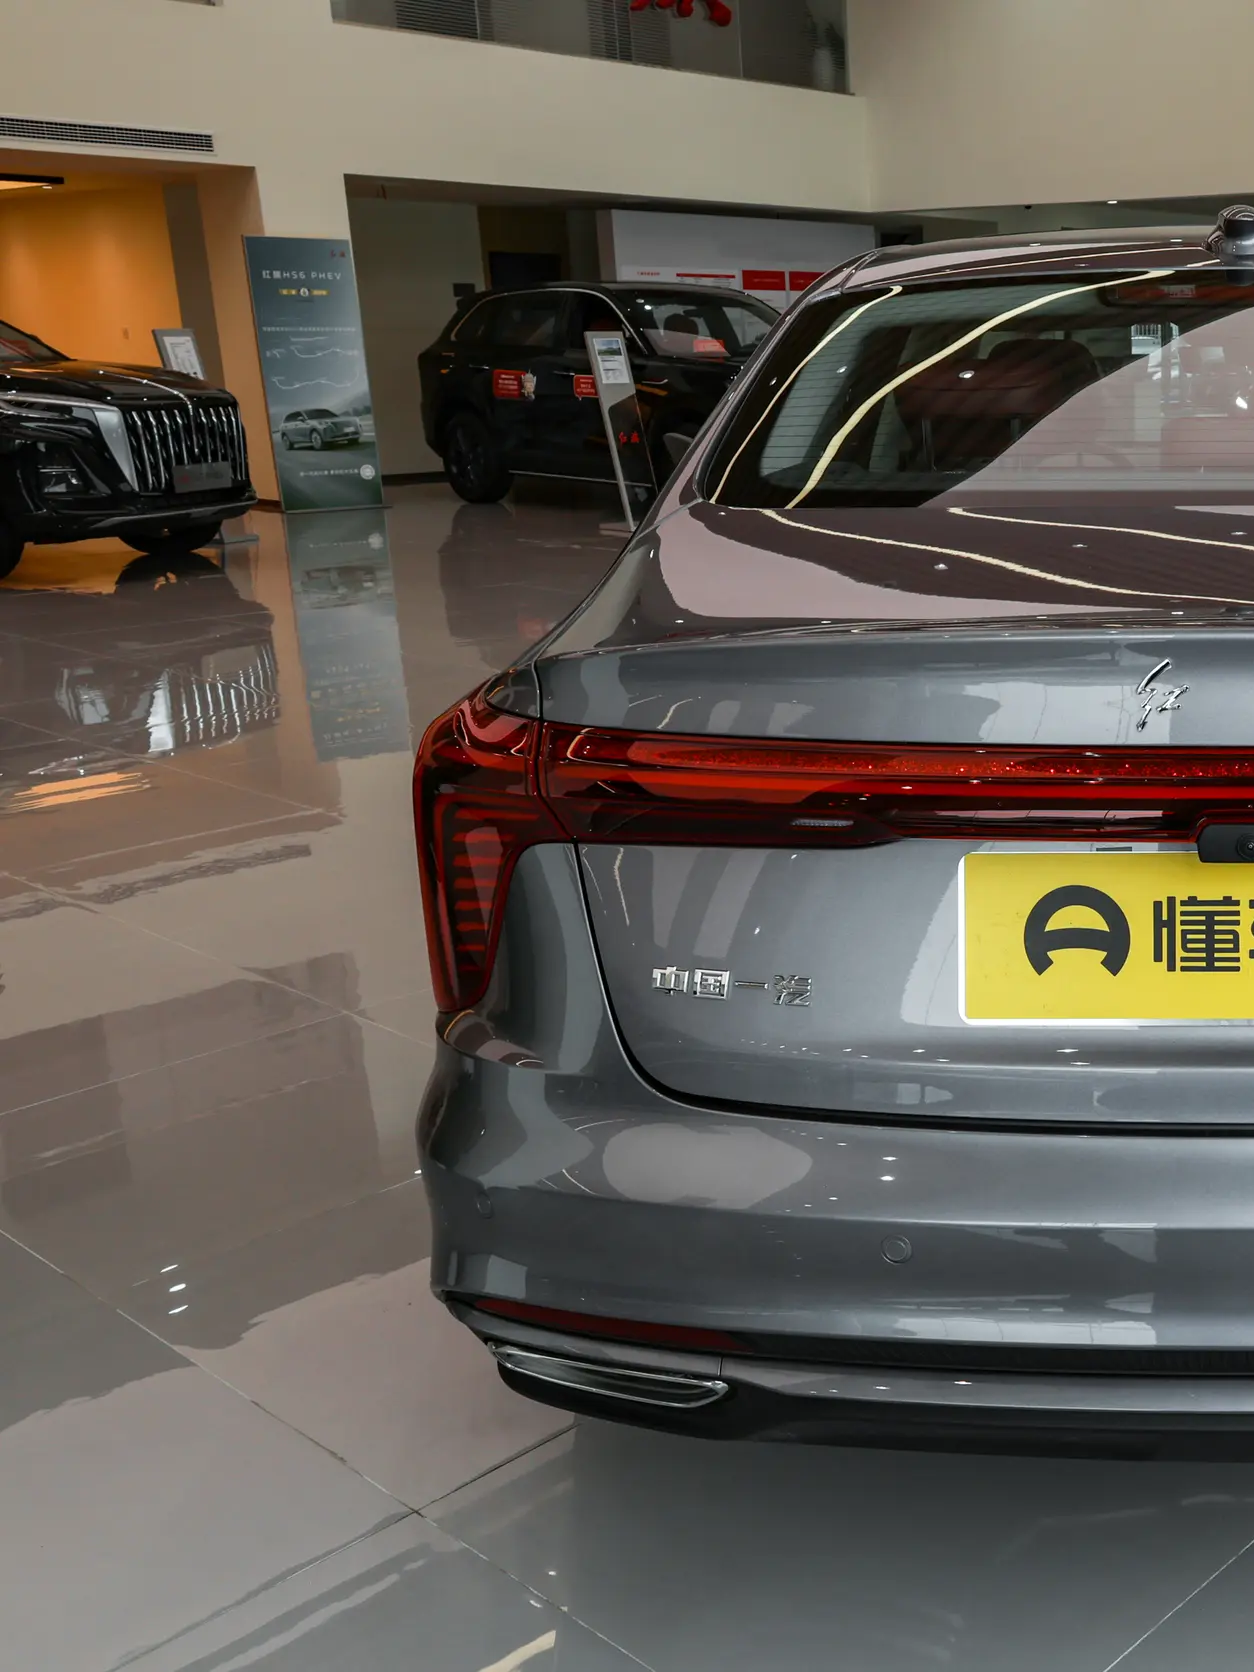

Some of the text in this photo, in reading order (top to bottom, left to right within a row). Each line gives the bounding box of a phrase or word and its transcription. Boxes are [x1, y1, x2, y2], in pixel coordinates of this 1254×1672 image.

[311, 271, 342, 280] PHEV
[651, 965, 813, 1007] 中国一汽
